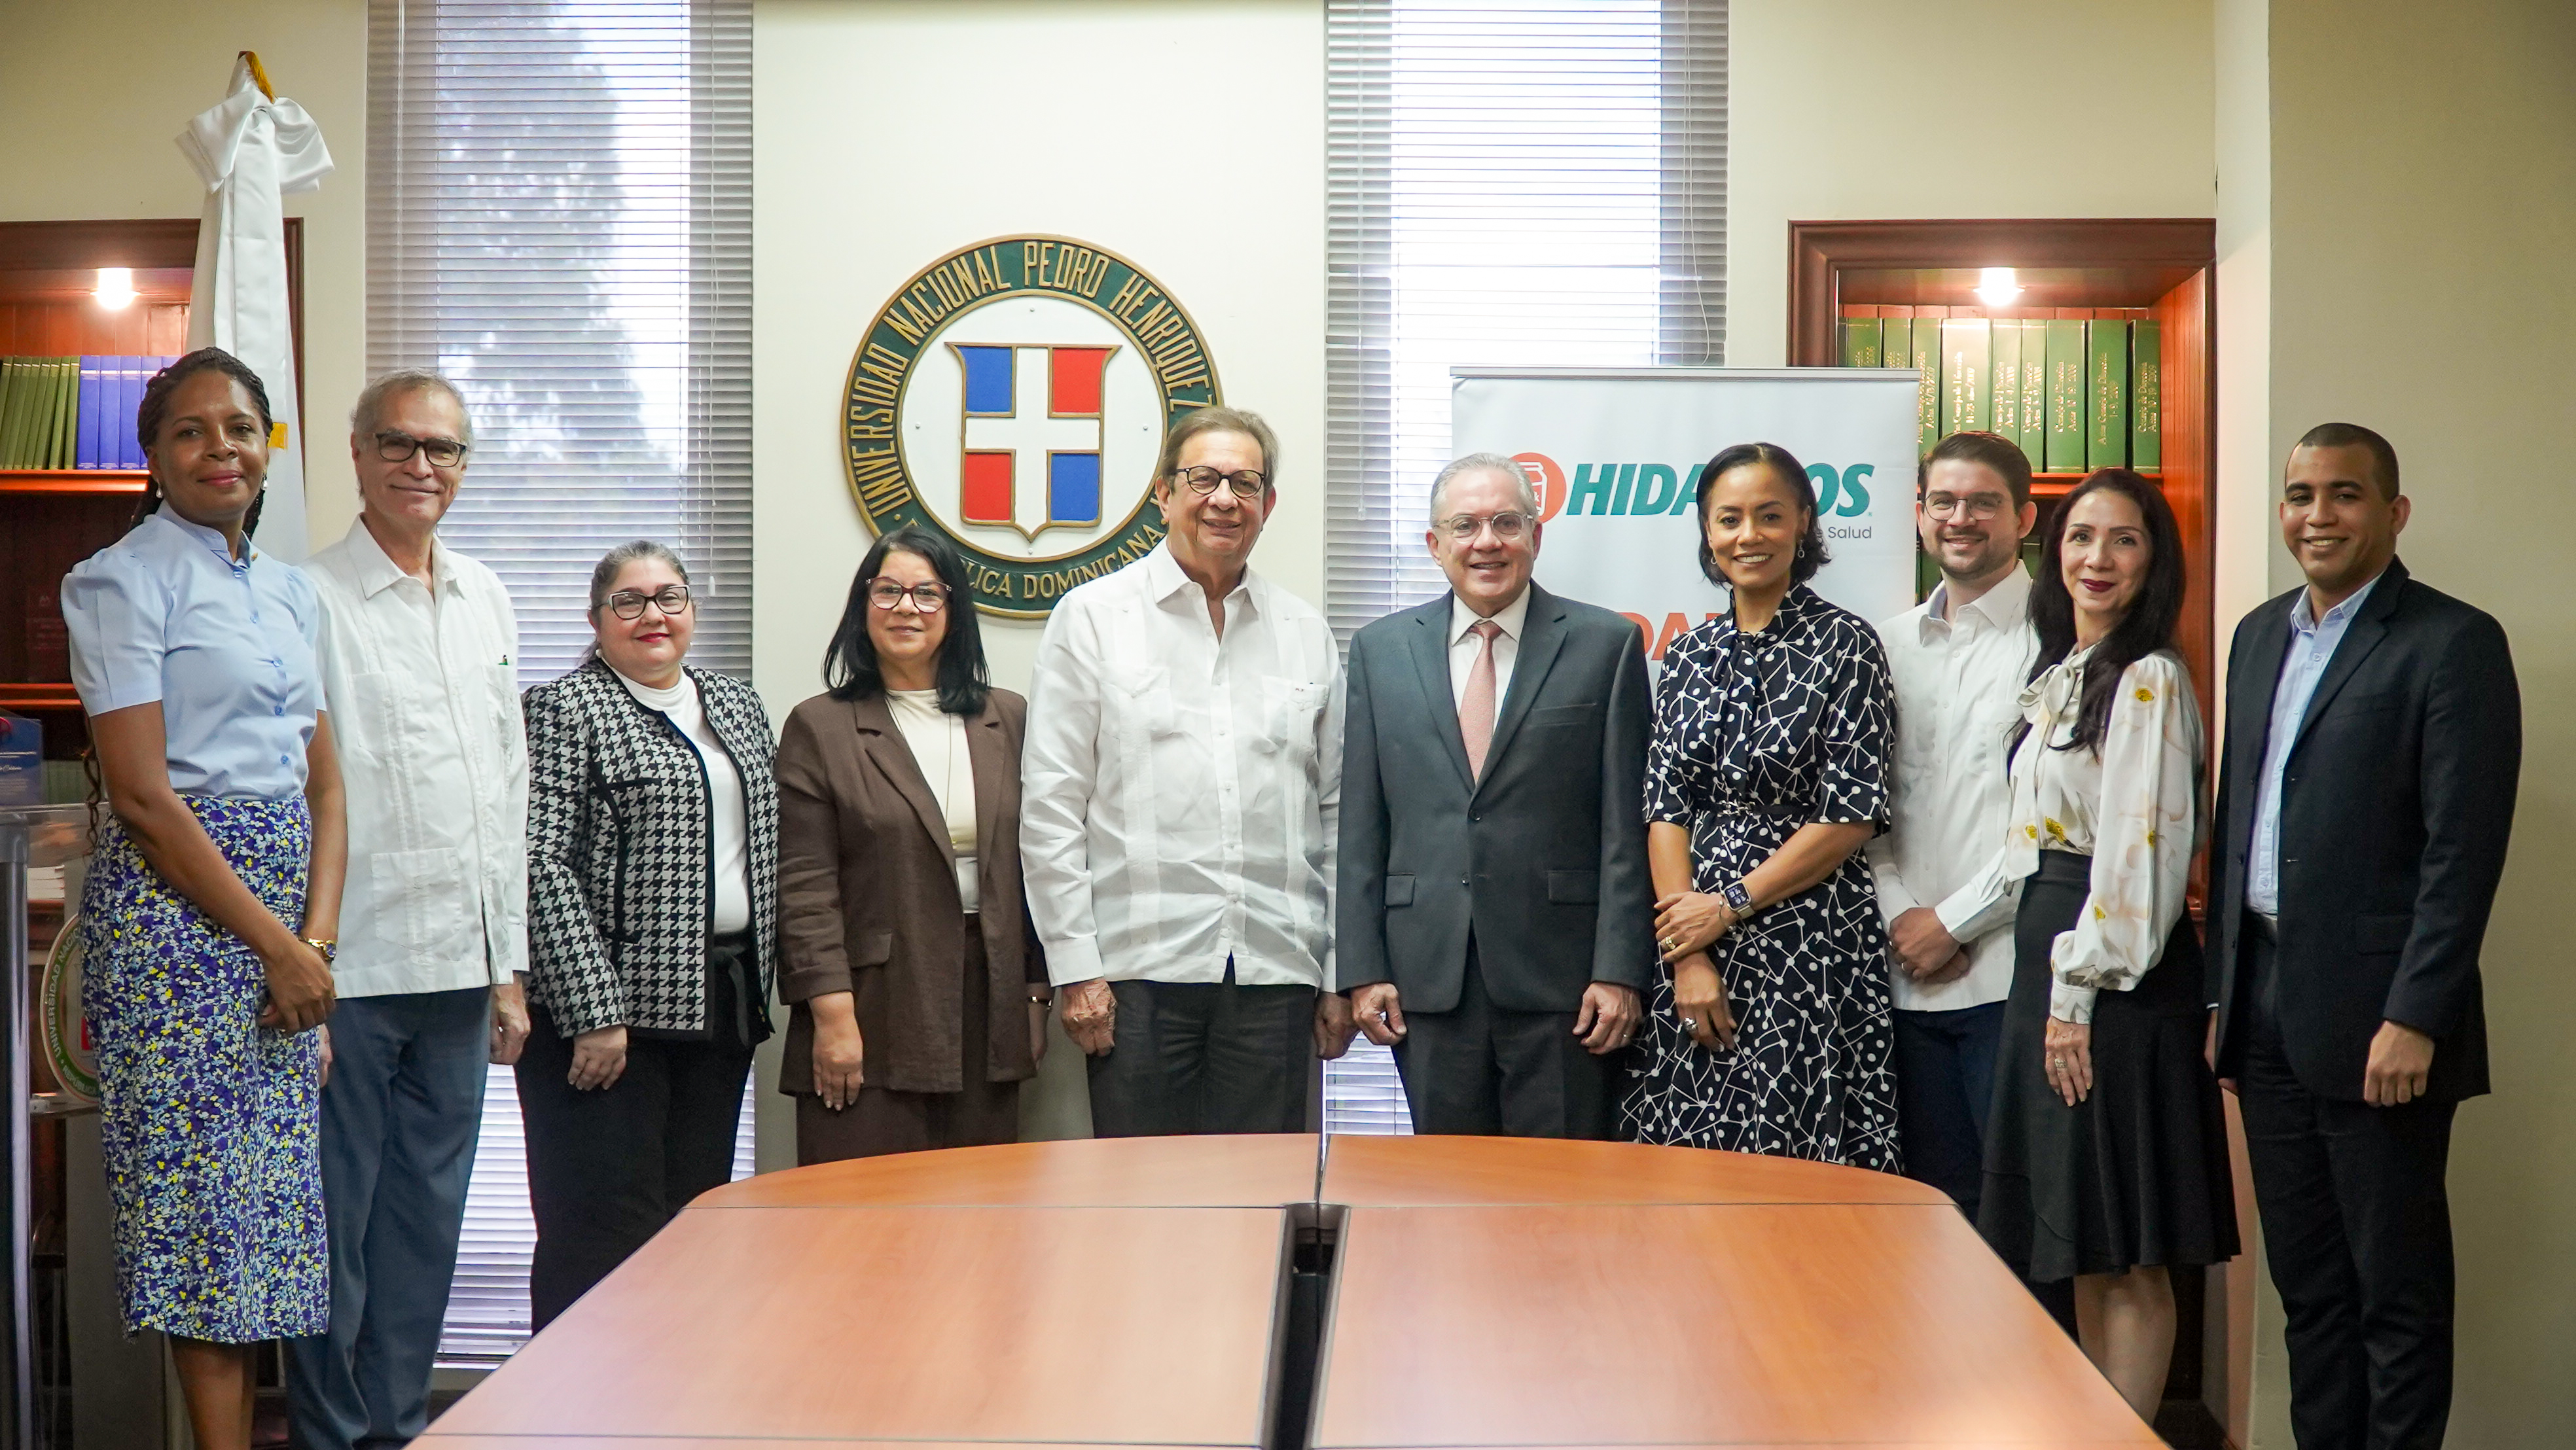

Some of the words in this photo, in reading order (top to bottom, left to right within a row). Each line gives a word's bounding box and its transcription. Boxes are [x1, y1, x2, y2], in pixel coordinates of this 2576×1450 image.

[851, 342, 912, 518] UNIVERSIDAD
[884, 245, 1011, 346] NACIONAL
[1024, 241, 1111, 298] PEDRO
[1108, 272, 1213, 412] HENRIQUEZ
[1566, 463, 1875, 517] HIDAOS
[1023, 524, 1166, 599] DOMINICANA
[1828, 526, 1872, 539] Salud
[48, 964, 62, 1058] UNIVERSIDAD
